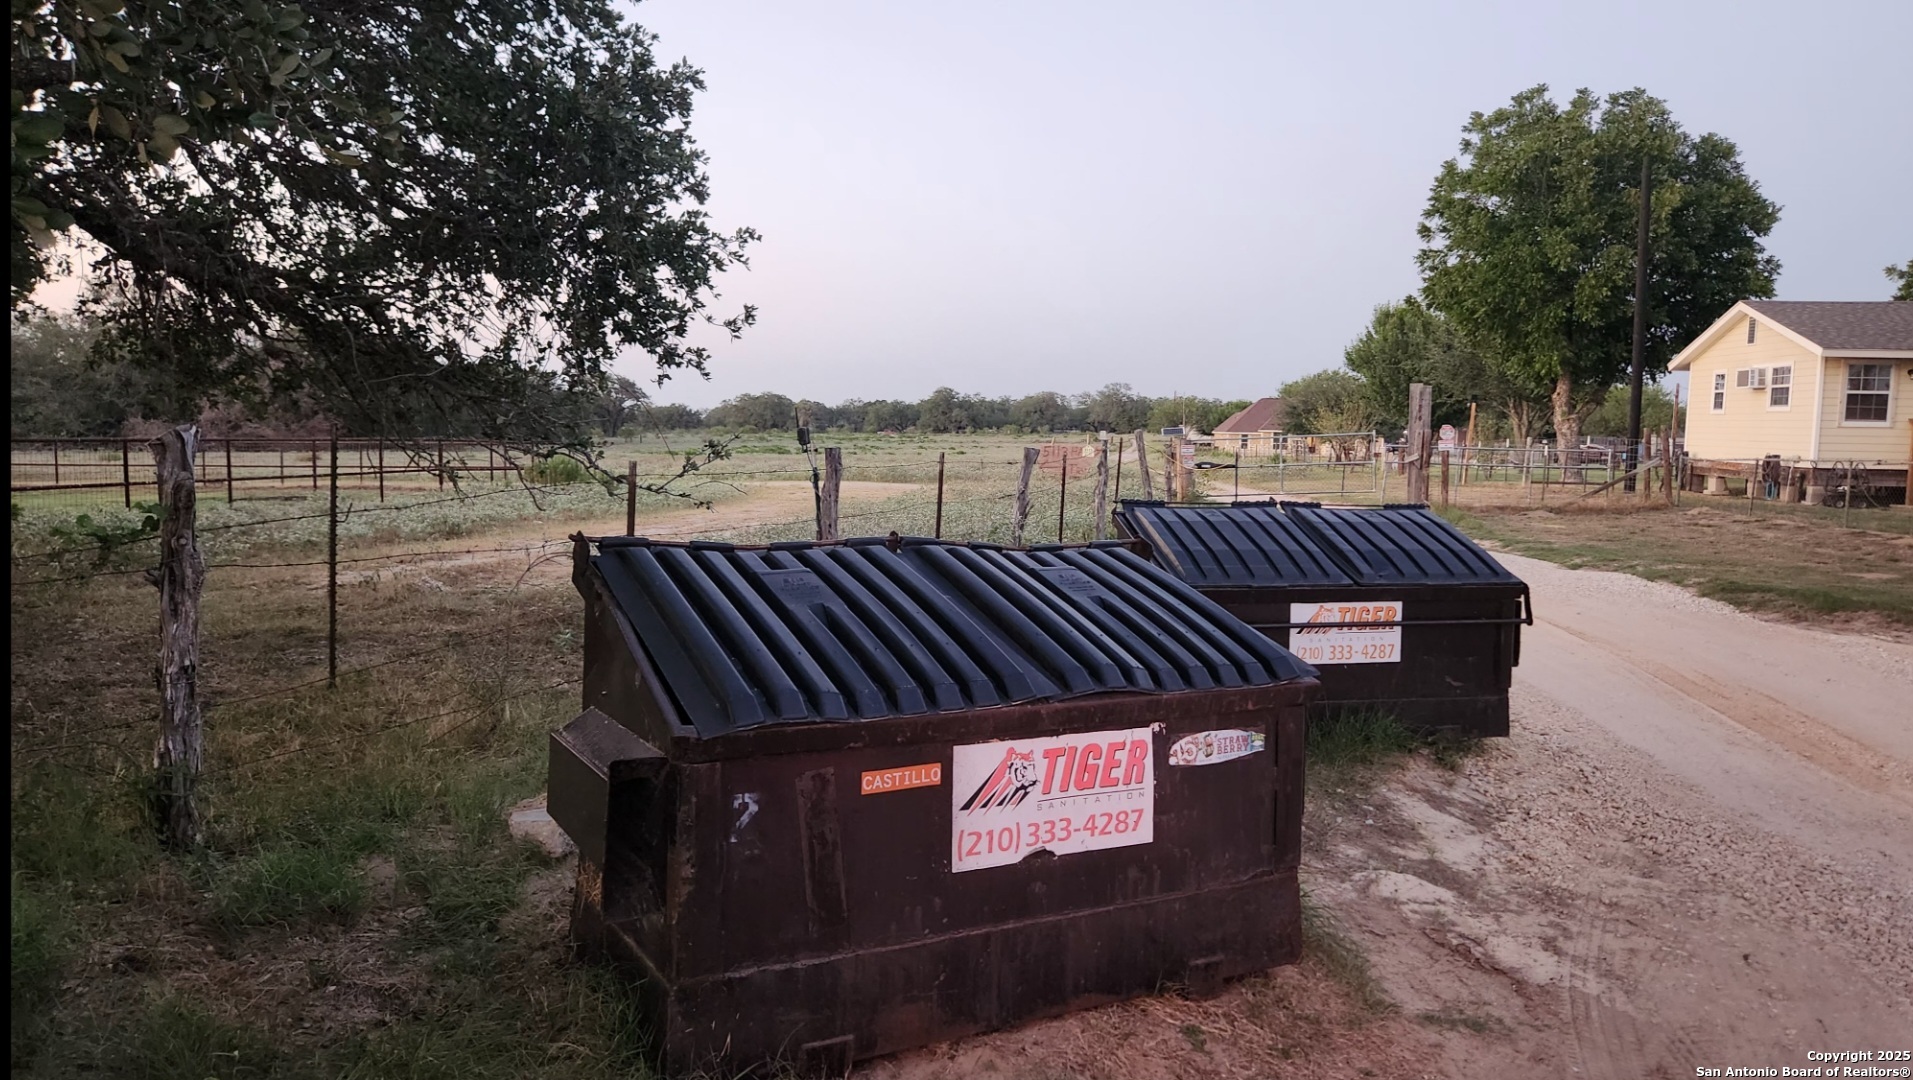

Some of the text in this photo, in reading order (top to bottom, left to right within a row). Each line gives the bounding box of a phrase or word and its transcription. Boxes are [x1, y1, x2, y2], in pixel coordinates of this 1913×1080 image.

[1337, 605, 1397, 631] TIGER
[1296, 646, 1323, 661] (210)
[1216, 734, 1249, 746] STRAW
[1216, 742, 1249, 755] BERRY
[862, 767, 941, 790] CASTILLO
[1041, 739, 1149, 796] TIGER
[1036, 790, 1145, 812] SANITATION
[957, 808, 1145, 862] (210) 333-4287
